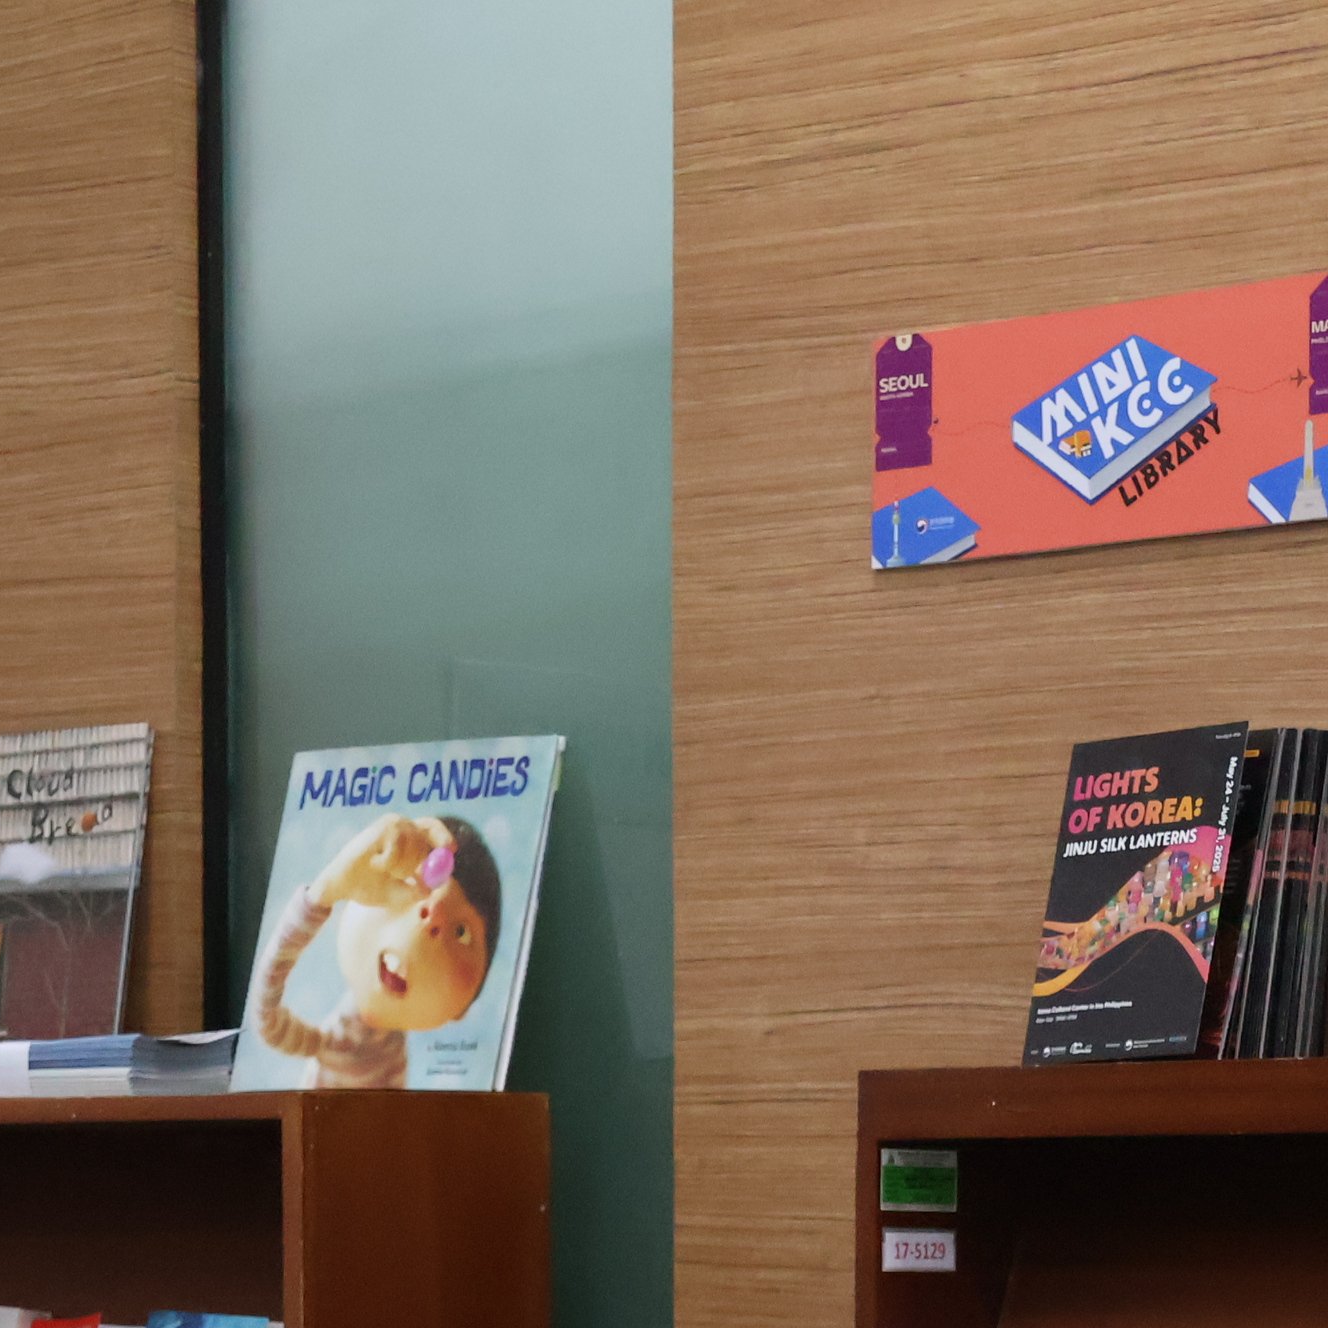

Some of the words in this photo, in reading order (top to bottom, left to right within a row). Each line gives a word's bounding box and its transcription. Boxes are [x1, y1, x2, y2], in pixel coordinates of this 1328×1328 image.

[878, 373, 929, 393] SEOUL
[1040, 338, 1148, 447] MINI
[1090, 356, 1196, 460] KCC
[1117, 408, 1223, 508] LIBRARY
[6, 769, 76, 800] Cloud
[1073, 766, 1160, 802] LIGHTS
[1068, 807, 1103, 834] OF
[1106, 796, 1205, 830] KOREA:
[1063, 838, 1099, 858] JINJU
[1099, 835, 1129, 855] SILK
[1129, 827, 1199, 851] LANTERNS
[894, 1242, 947, 1260] 17-5129
